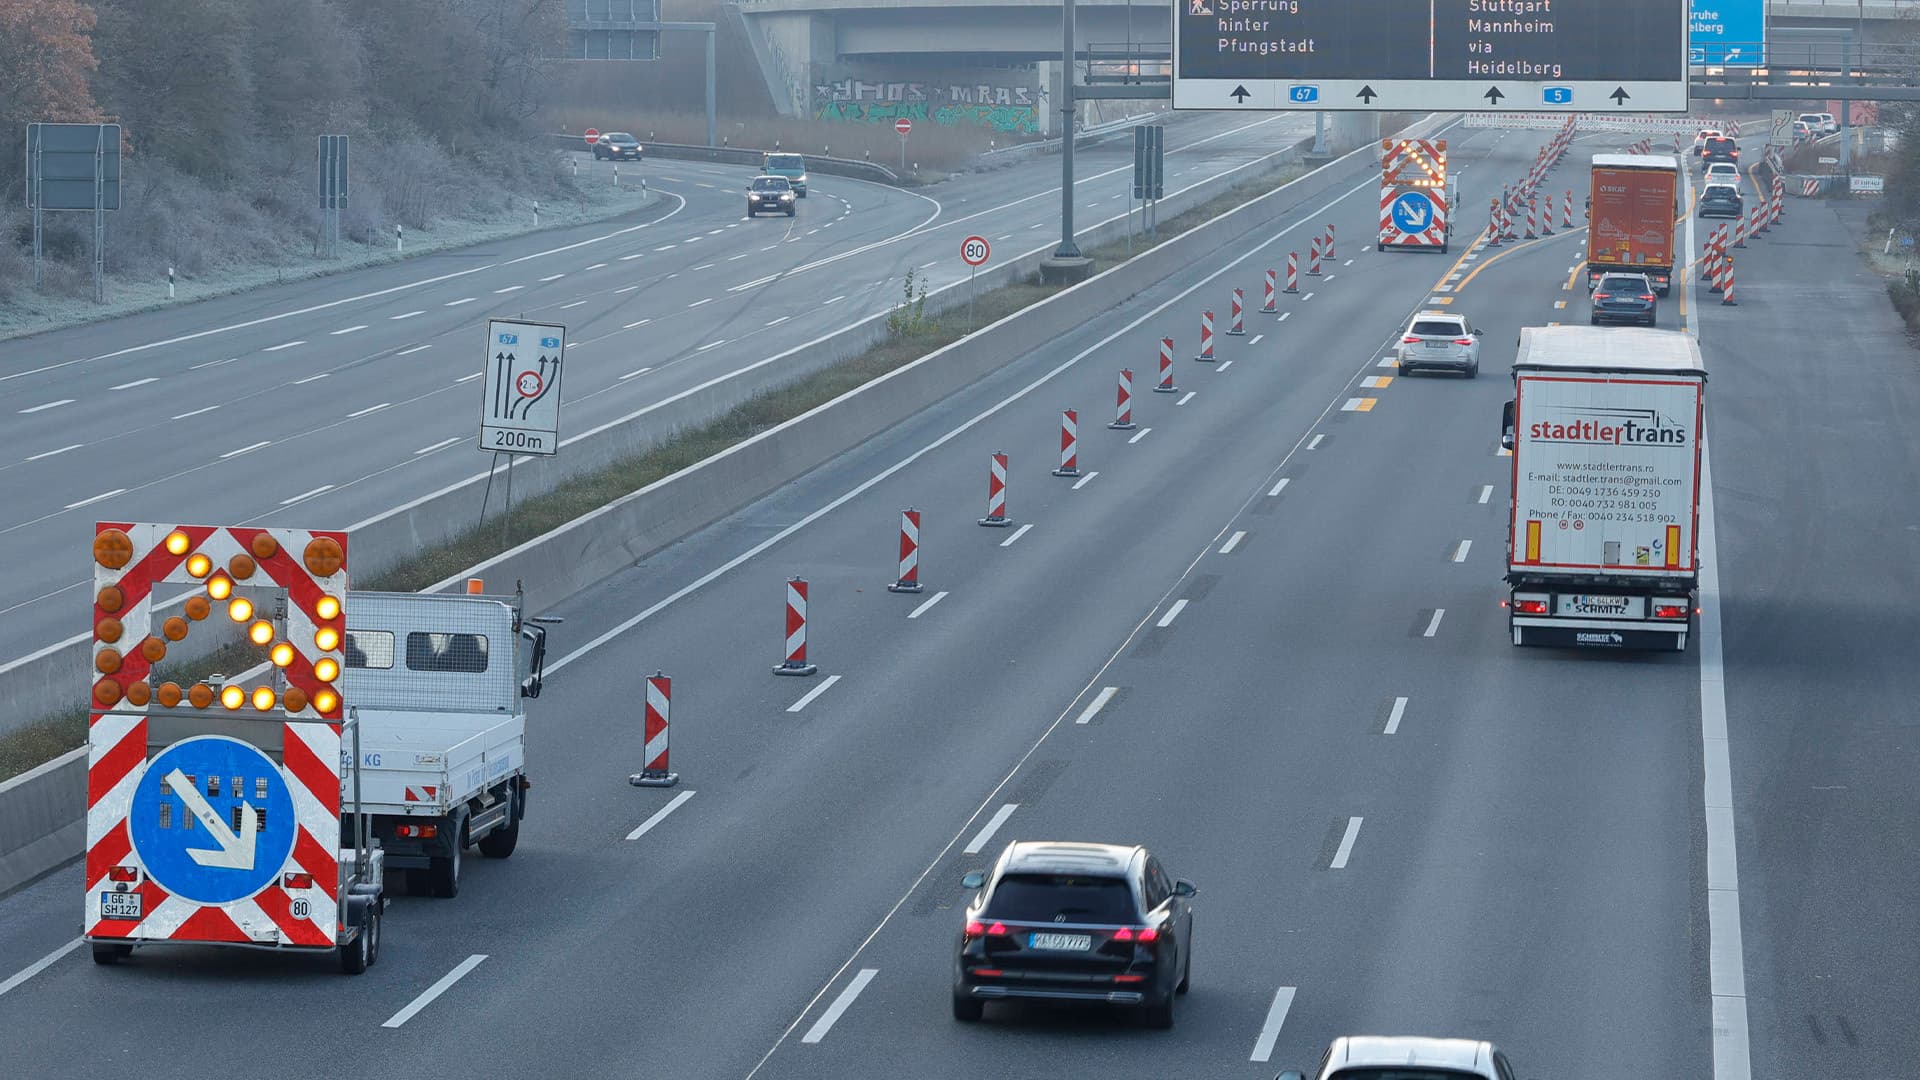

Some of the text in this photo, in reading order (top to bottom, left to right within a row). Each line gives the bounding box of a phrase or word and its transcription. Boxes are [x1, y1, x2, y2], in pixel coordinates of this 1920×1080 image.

[1219, 0, 1298, 14] Sperrung
[1469, 0, 1551, 15] Stuttgart
[1218, 18, 1269, 32] hinter
[1468, 19, 1553, 33] Mannheim
[1218, 39, 1315, 55] Pfungstadt
[1468, 40, 1492, 53] via
[1468, 60, 1561, 78] Heidelberg
[1295, 88, 1311, 100] 67
[1554, 89, 1562, 101] 5
[966, 243, 984, 258] 80
[501, 334, 513, 344] 67
[547, 338, 554, 348] 5
[1530, 420, 1686, 445] stadtlertrans
[495, 431, 542, 449] 200m
[1557, 462, 1654, 473] www.stadtlertrans.ro
[1528, 472, 1682, 487] E-mail: stadtler.trans@gmail.com
[1548, 485, 1661, 498] DE: 0049 1736 459 250
[1551, 497, 1657, 510] RO: 0040 732 981 005
[1529, 509, 1559, 519] Phone
[1567, 510, 1586, 520] Fax:
[1588, 511, 1614, 521] 0040
[1615, 512, 1634, 522] 234
[1636, 513, 1655, 522] 518
[1657, 514, 1676, 523] 902
[1575, 605, 1626, 614] SCHMITZ
[364, 753, 382, 766] KG
[111, 894, 124, 904] GG
[104, 904, 138, 915] SH 127
[293, 901, 308, 916] 80
